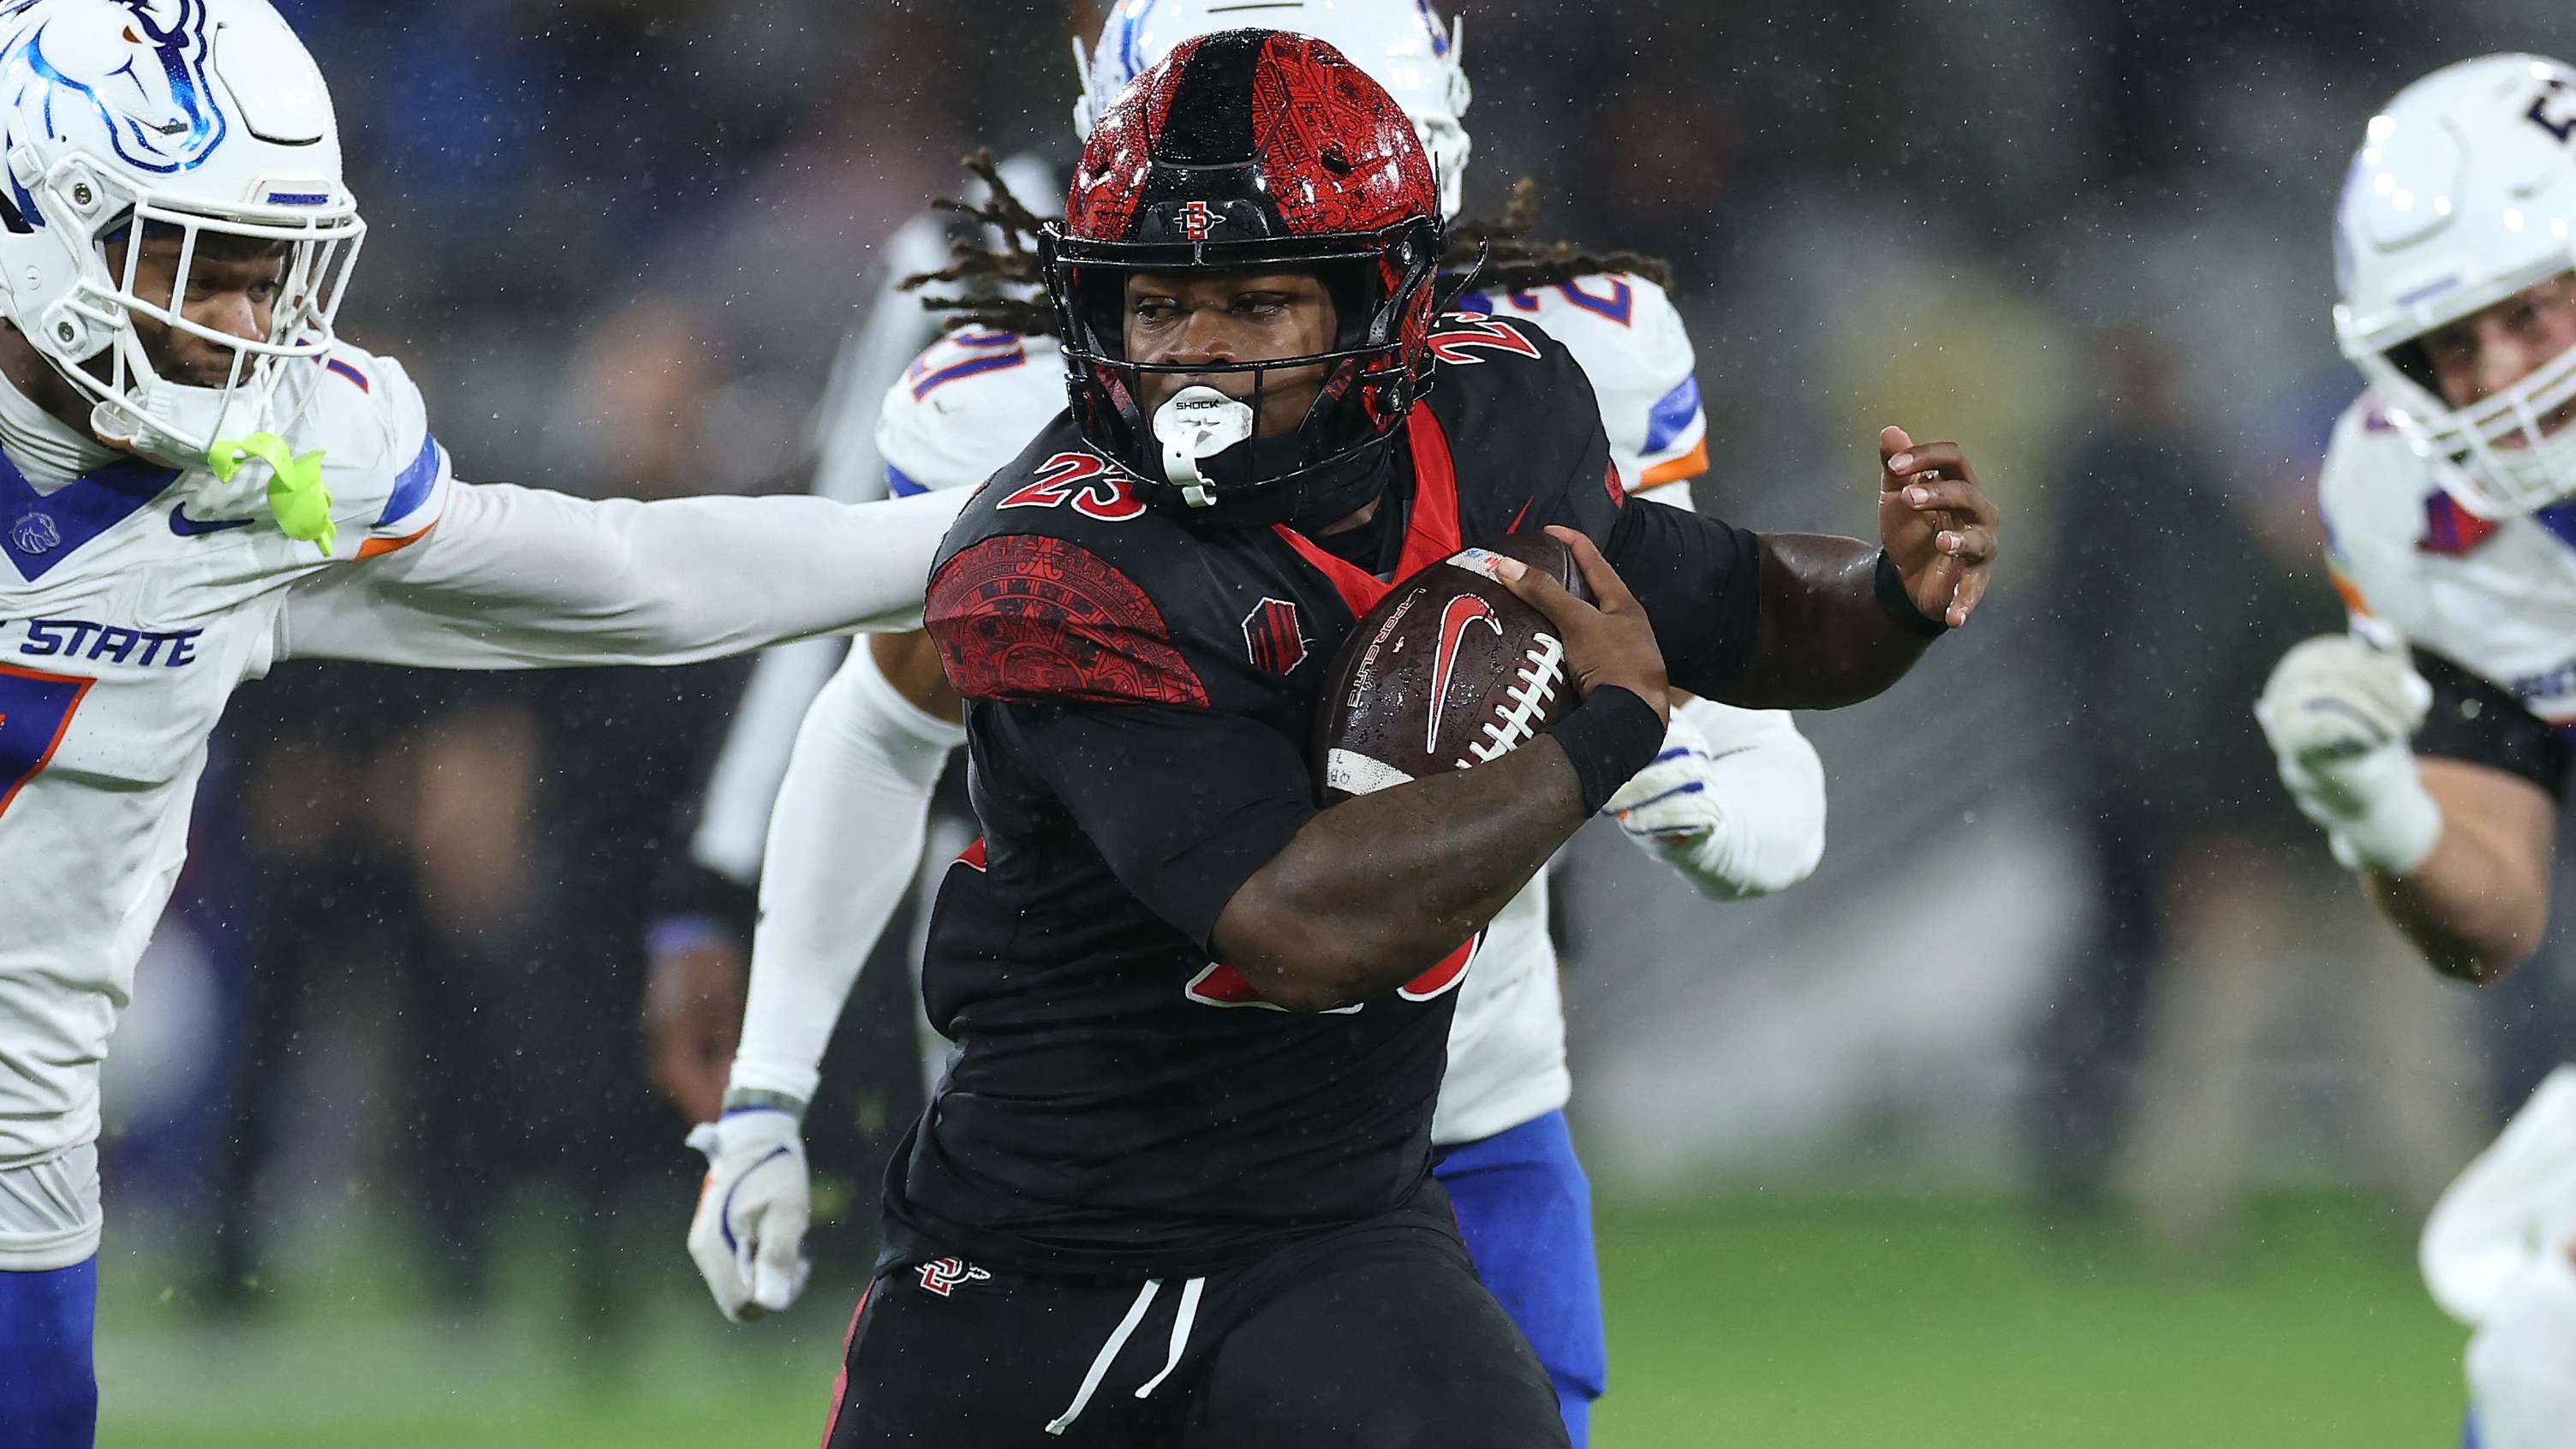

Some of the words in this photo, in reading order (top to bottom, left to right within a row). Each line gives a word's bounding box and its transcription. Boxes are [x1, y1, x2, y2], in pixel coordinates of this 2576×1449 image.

[1176, 399, 1219, 410] SHOCK
[995, 451, 1148, 522] 23
[19, 618, 205, 667] STATE
